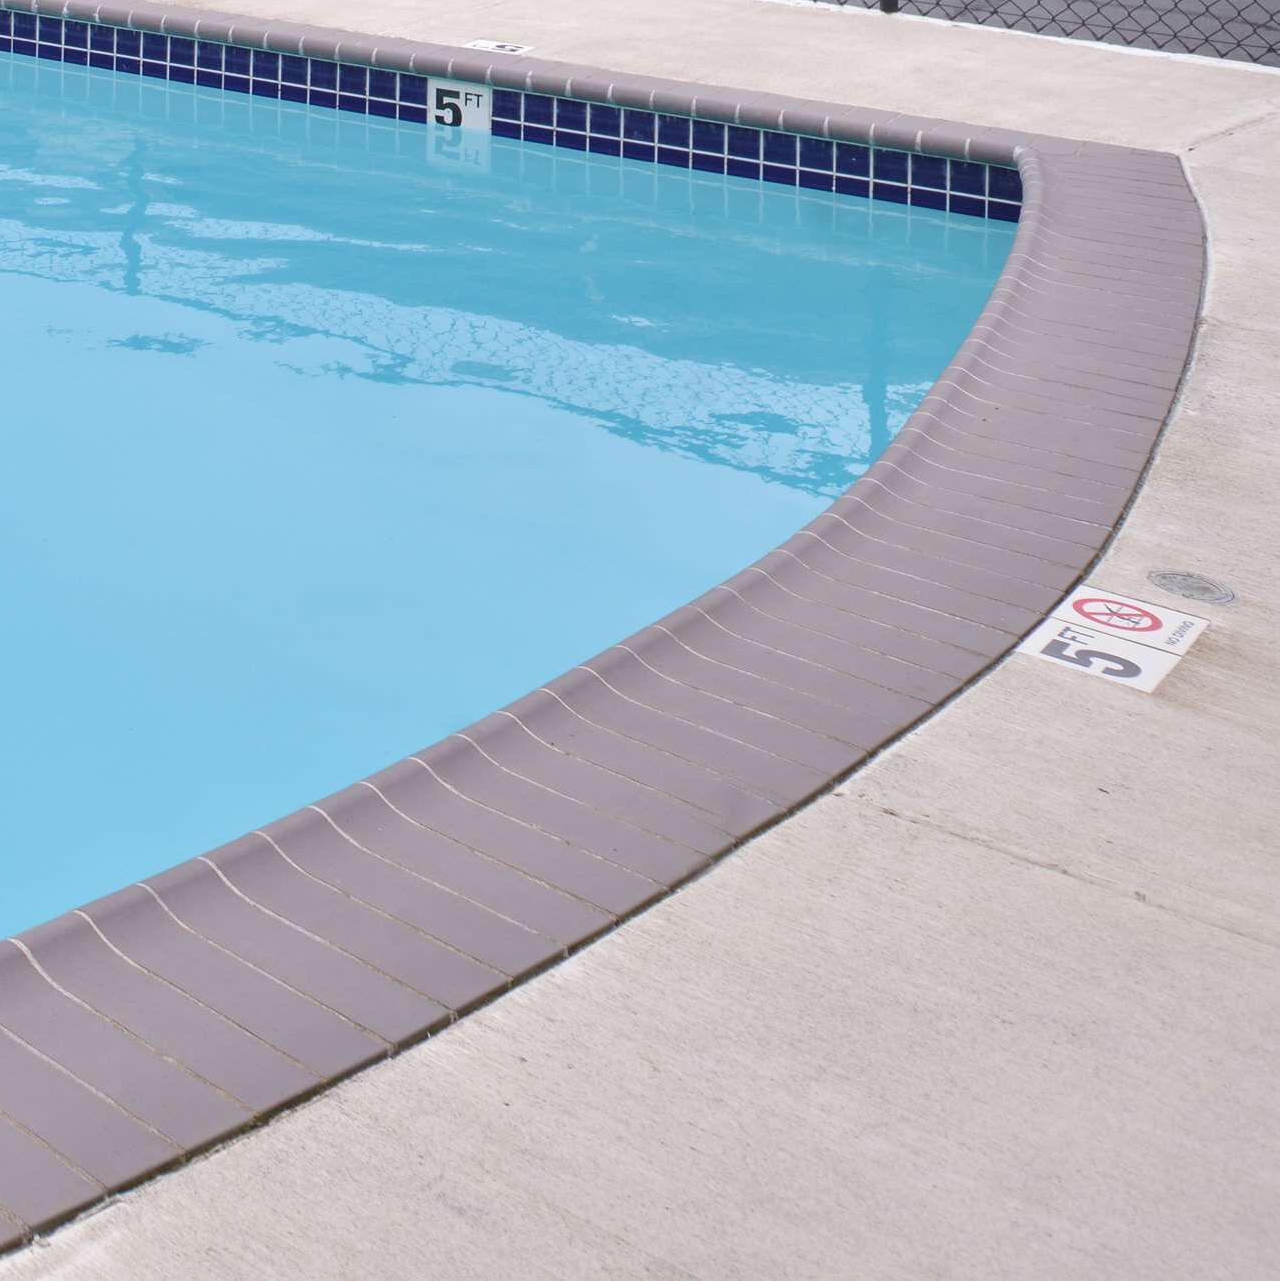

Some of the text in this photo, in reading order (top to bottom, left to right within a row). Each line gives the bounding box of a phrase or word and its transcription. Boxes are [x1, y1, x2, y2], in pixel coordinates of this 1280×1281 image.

[435, 88, 483, 127] 5 FT
[1040, 626, 1142, 678] 5 FT
